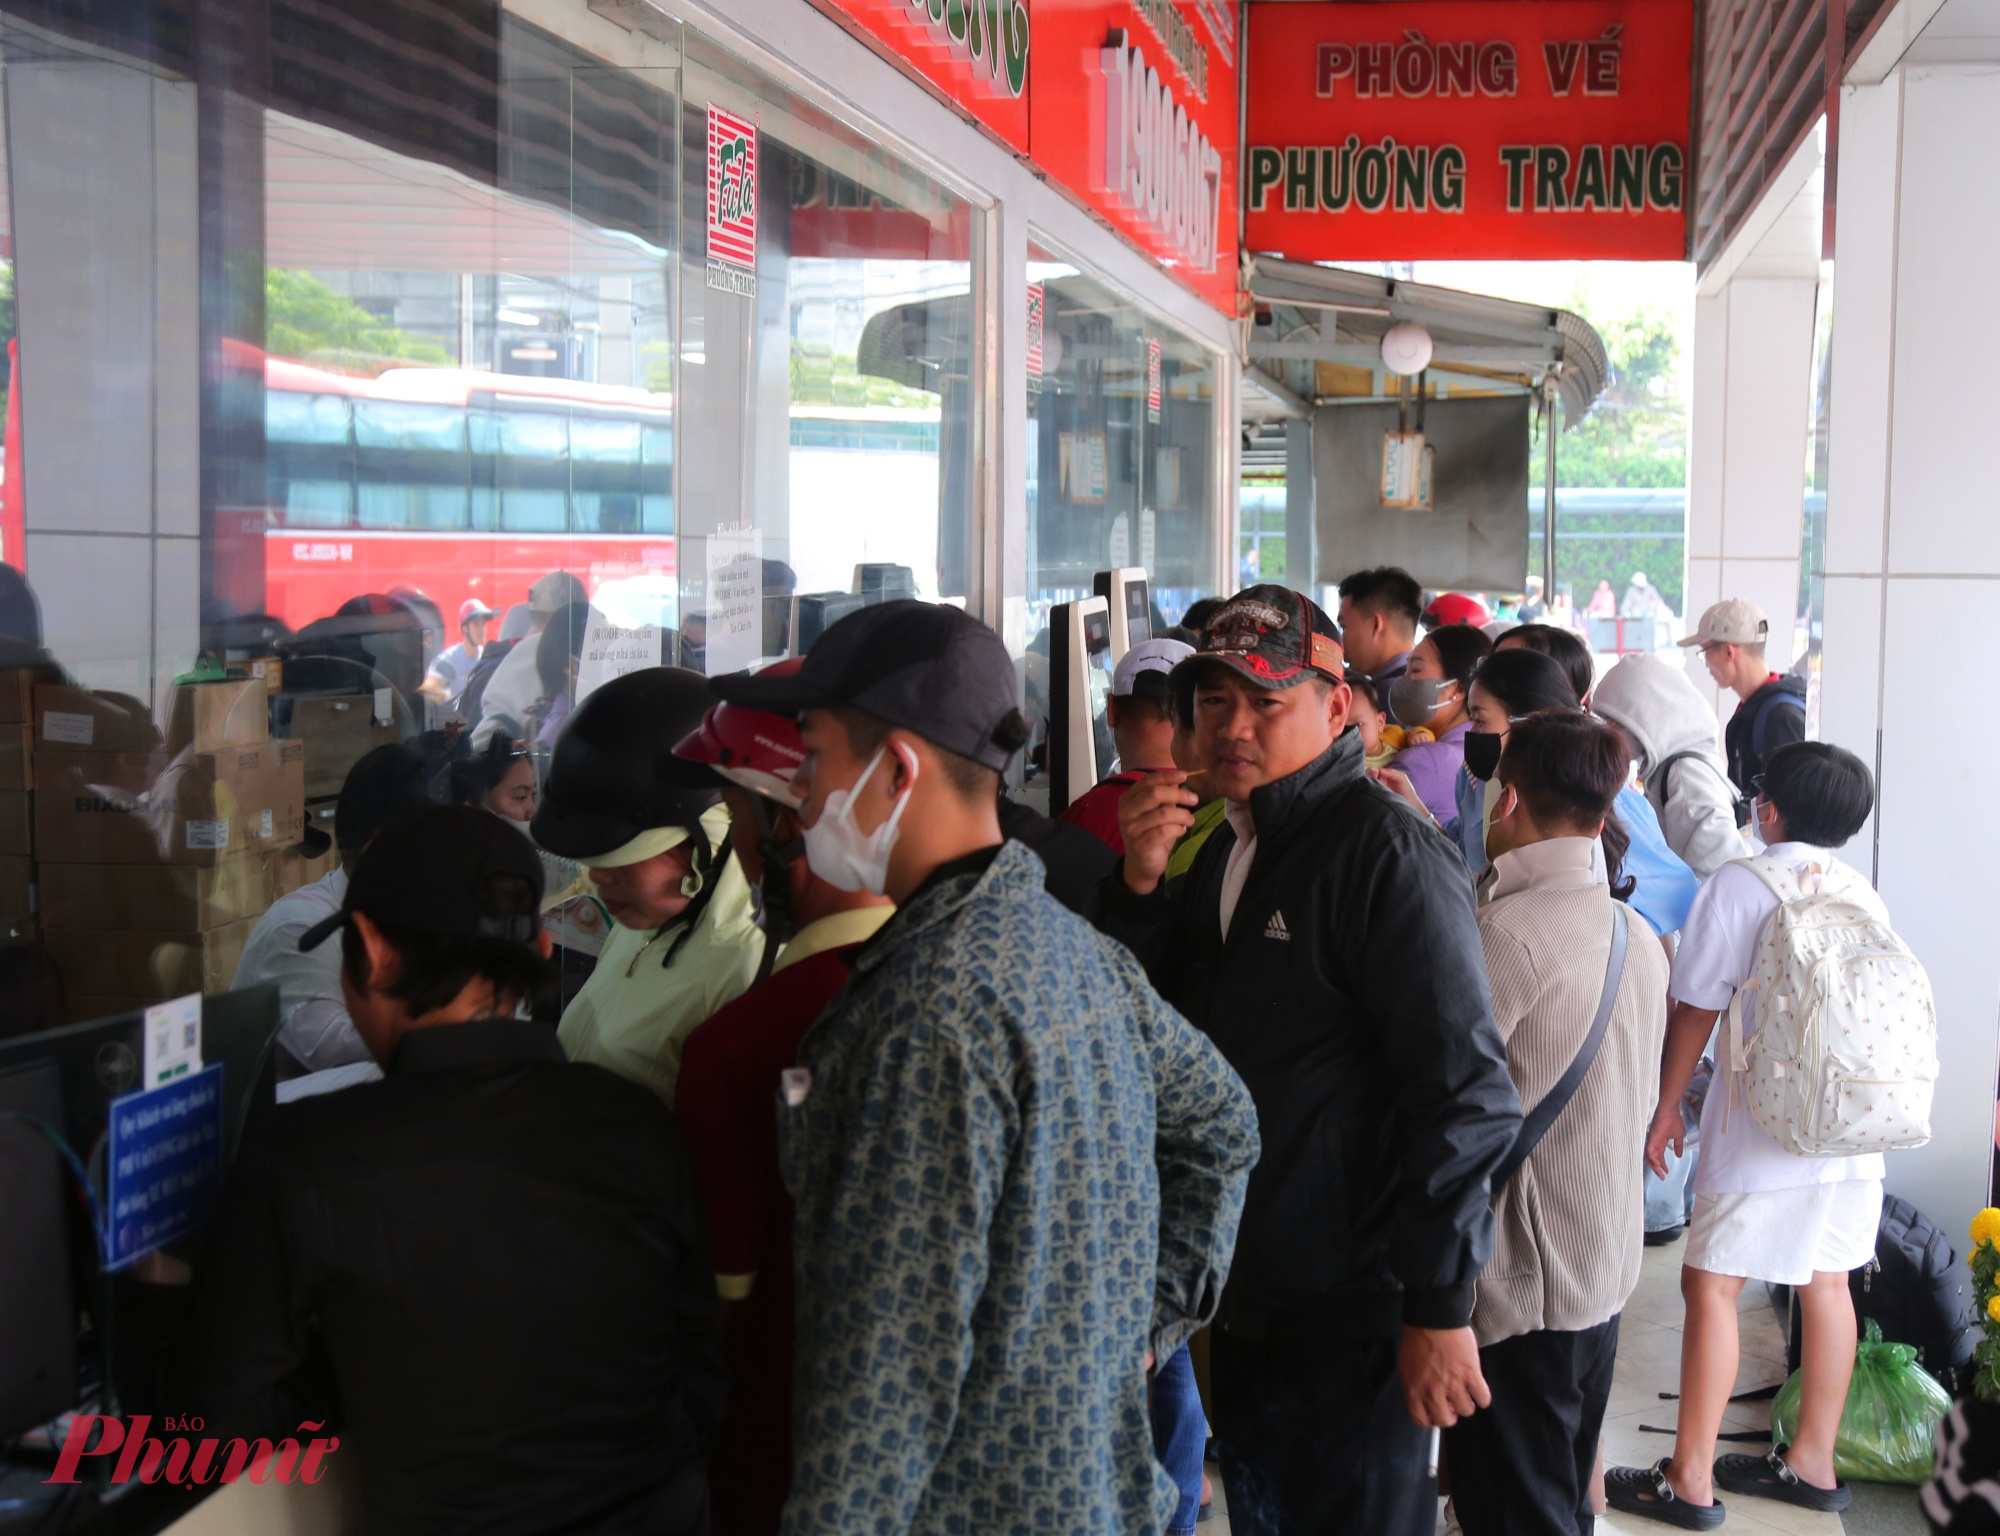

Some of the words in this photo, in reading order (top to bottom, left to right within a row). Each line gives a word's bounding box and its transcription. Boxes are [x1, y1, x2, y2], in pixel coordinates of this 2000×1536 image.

[1316, 28, 1517, 98] PHÒNG
[1542, 23, 1623, 97] VÉ
[1103, 27, 1221, 274] 19006067
[1249, 134, 1466, 213] PHƯƠNG
[1500, 142, 1684, 213] TRANG
[719, 588, 731, 601] CODE
[601, 627, 619, 640] CODE
[1264, 928, 1291, 941] adidas
